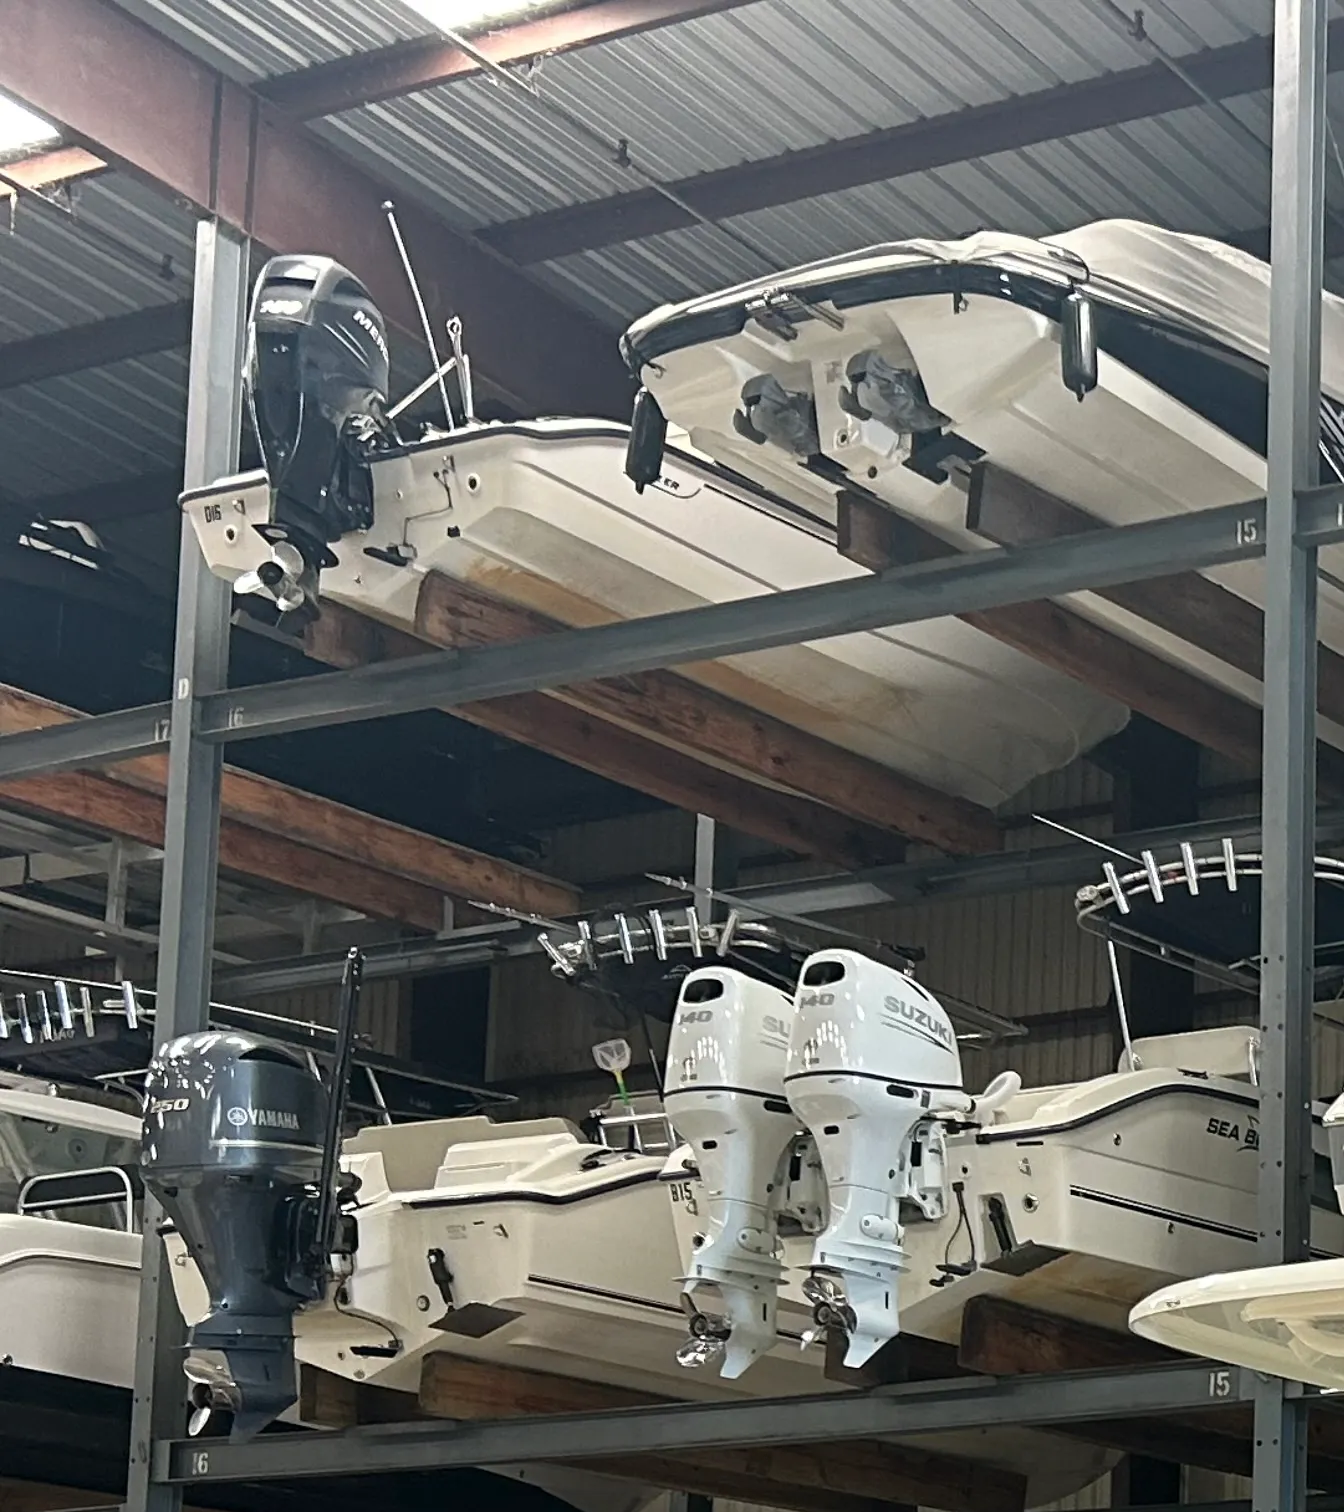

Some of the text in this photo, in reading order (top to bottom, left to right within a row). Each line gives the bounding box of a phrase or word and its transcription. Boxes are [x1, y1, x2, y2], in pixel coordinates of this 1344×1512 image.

[1236, 519, 1257, 545] 15
[177, 678, 190, 700] D
[228, 707, 245, 727] 16
[800, 993, 835, 1008] 140
[679, 1010, 713, 1025] 140
[884, 996, 952, 1046] SUZUKI
[249, 1109, 300, 1130] YAMAHA
[1207, 1117, 1240, 1142] SEA
[671, 1182, 692, 1201] B15
[1209, 1372, 1230, 1397] 15
[192, 1452, 209, 1475] 16
